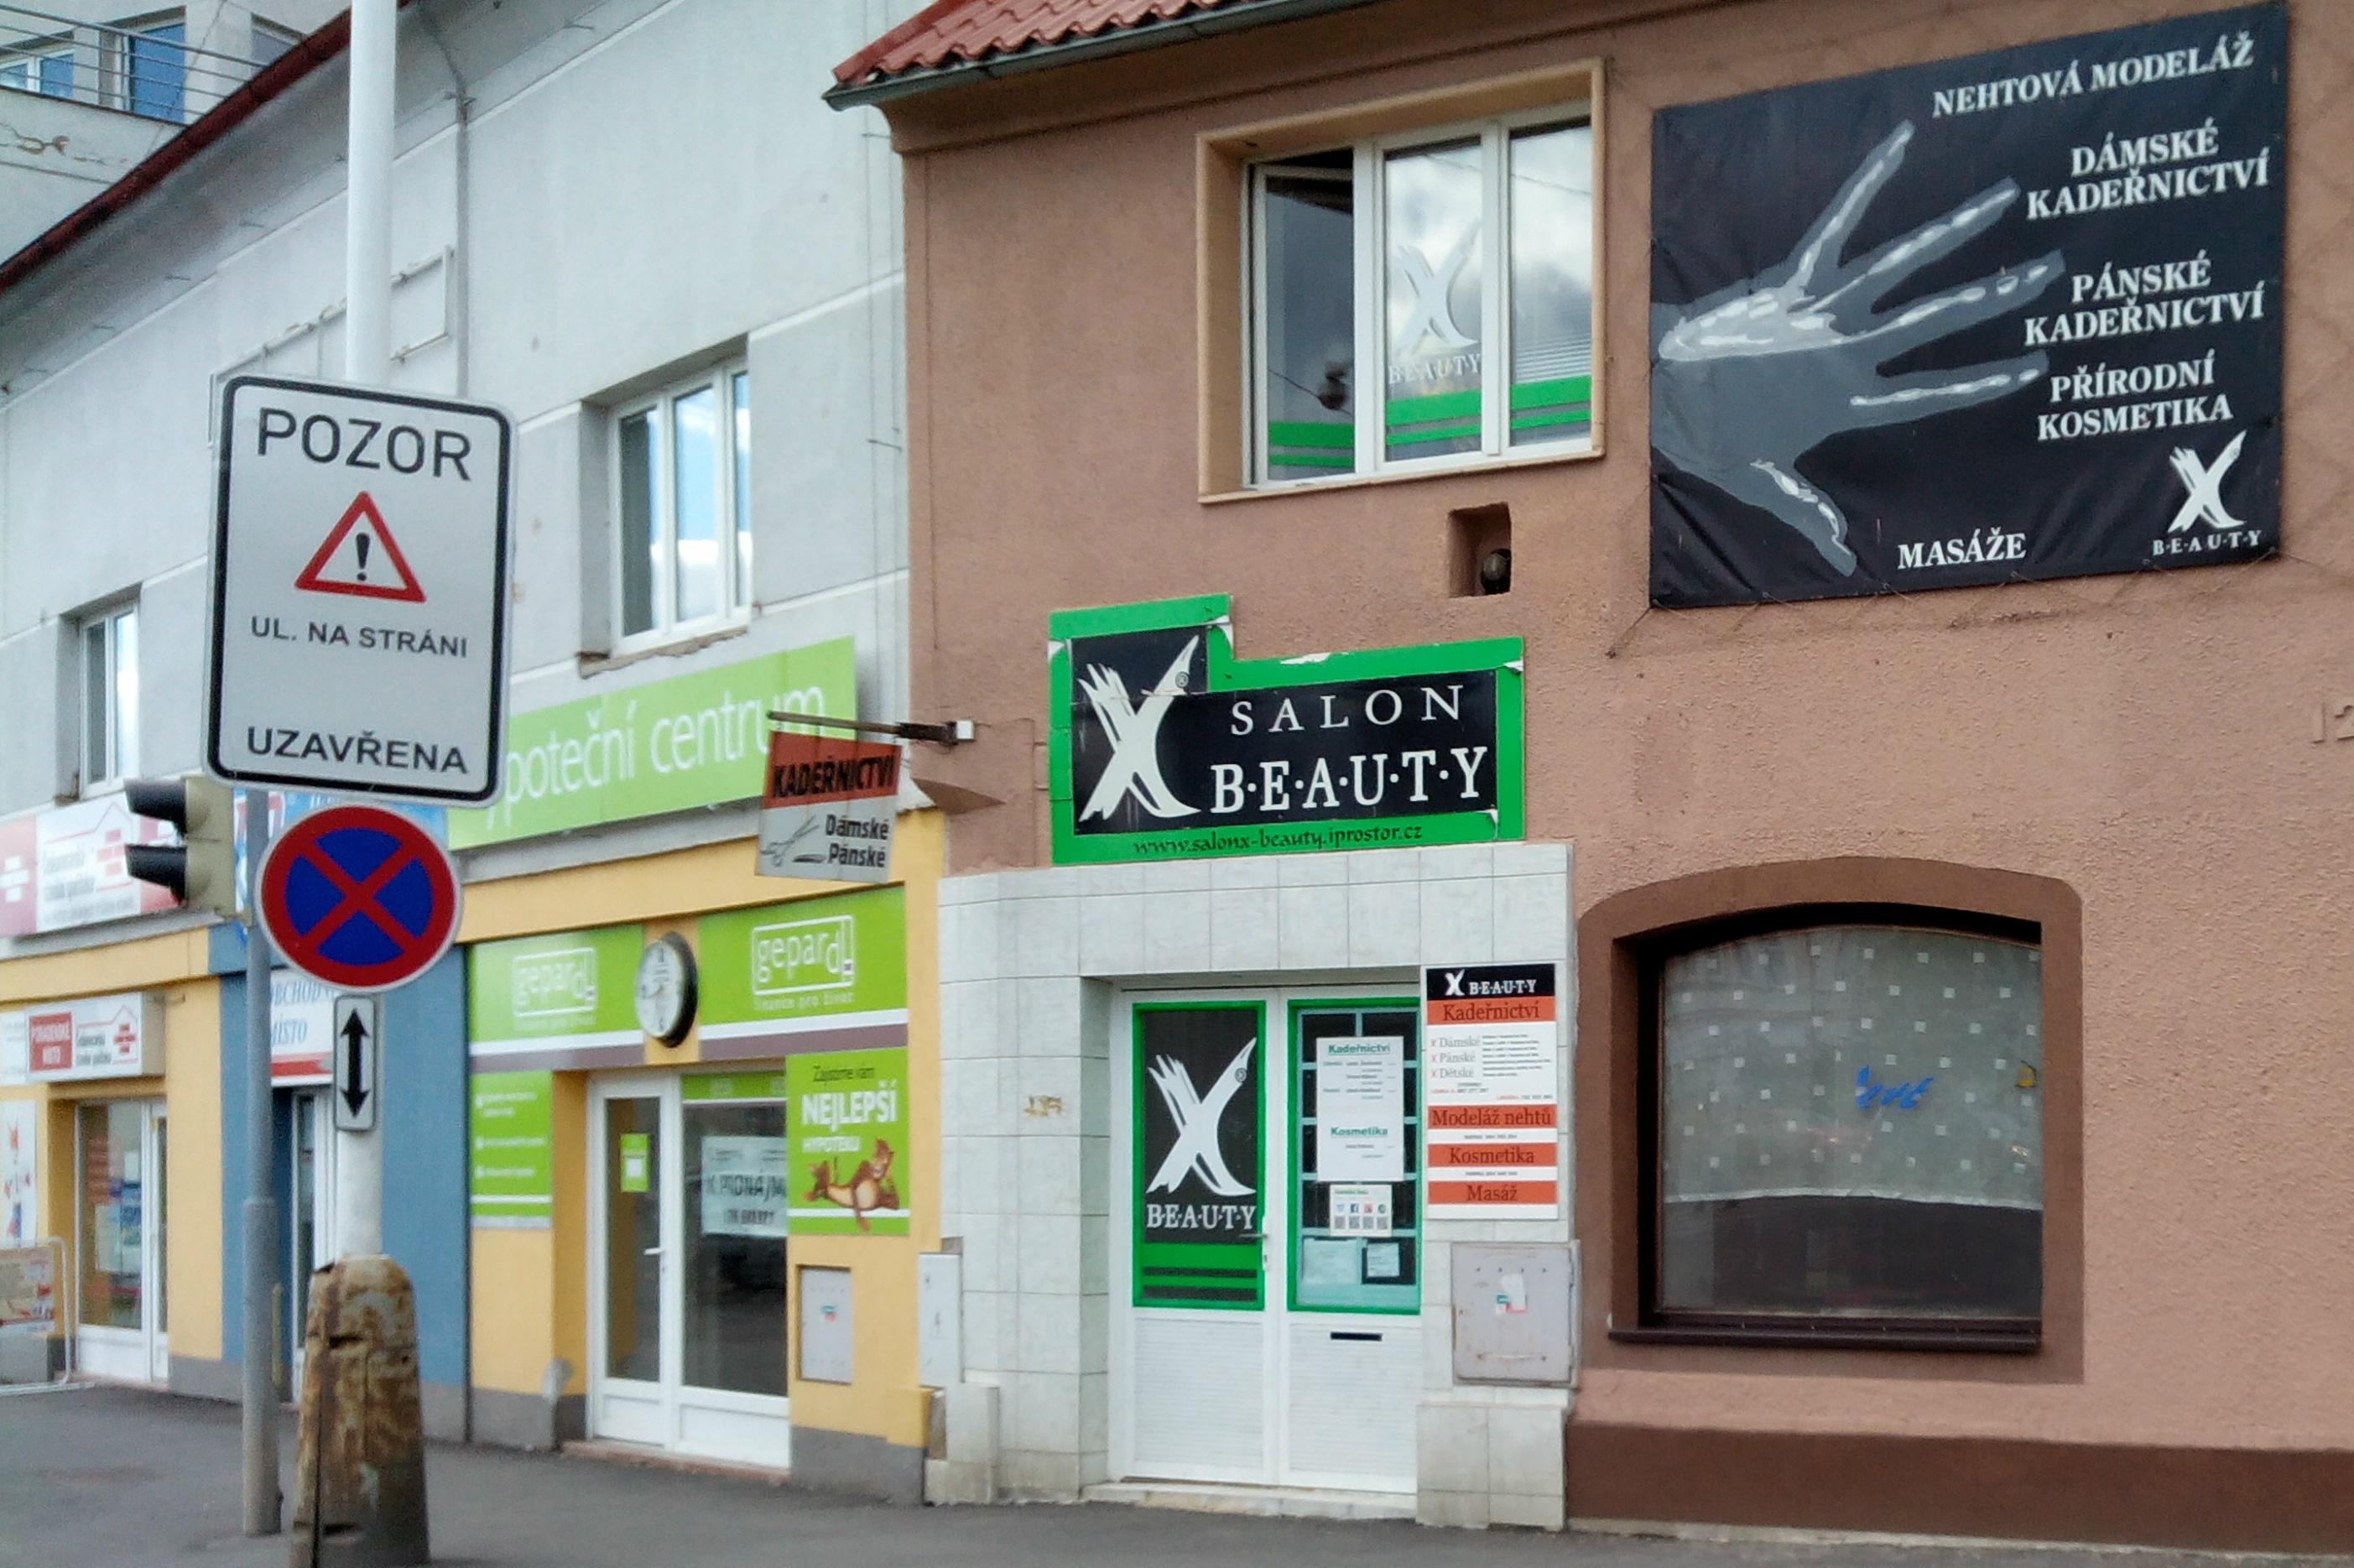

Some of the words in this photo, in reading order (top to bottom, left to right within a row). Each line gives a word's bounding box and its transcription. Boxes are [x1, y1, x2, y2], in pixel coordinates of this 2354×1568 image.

[1932, 60, 2083, 117] NEHTOVÁ
[2091, 30, 2254, 90] MODELÁŽ
[2070, 116, 2219, 177] DÁMSKÉ
[2028, 147, 2270, 220] KADEŘNICTVÍ
[2071, 249, 2211, 305] PÁNSKÉ
[2024, 280, 2265, 346] KADEŘNICTVÍ
[2049, 348, 2216, 403] PŘÍRODNÍ
[2037, 393, 2233, 442] KOSMETIKA
[257, 407, 471, 481] POZOR
[1897, 526, 2027, 570] MASÁŽE
[251, 615, 297, 643] UL.
[309, 622, 349, 645] NA
[359, 625, 469, 659] STRÁNI
[1231, 684, 1465, 737] SALON
[247, 727, 469, 775] UZAVŘENA
[483, 699, 638, 831] poteční
[825, 814, 890, 840] Dámské
[827, 841, 887, 868] Pánské
[1443, 1000, 1540, 1022] Kadeřnictví
[1431, 1107, 1501, 1127] Modeláž
[1449, 1146, 1534, 1164] Kosmetika
[1466, 1183, 1518, 1201] Masáž
